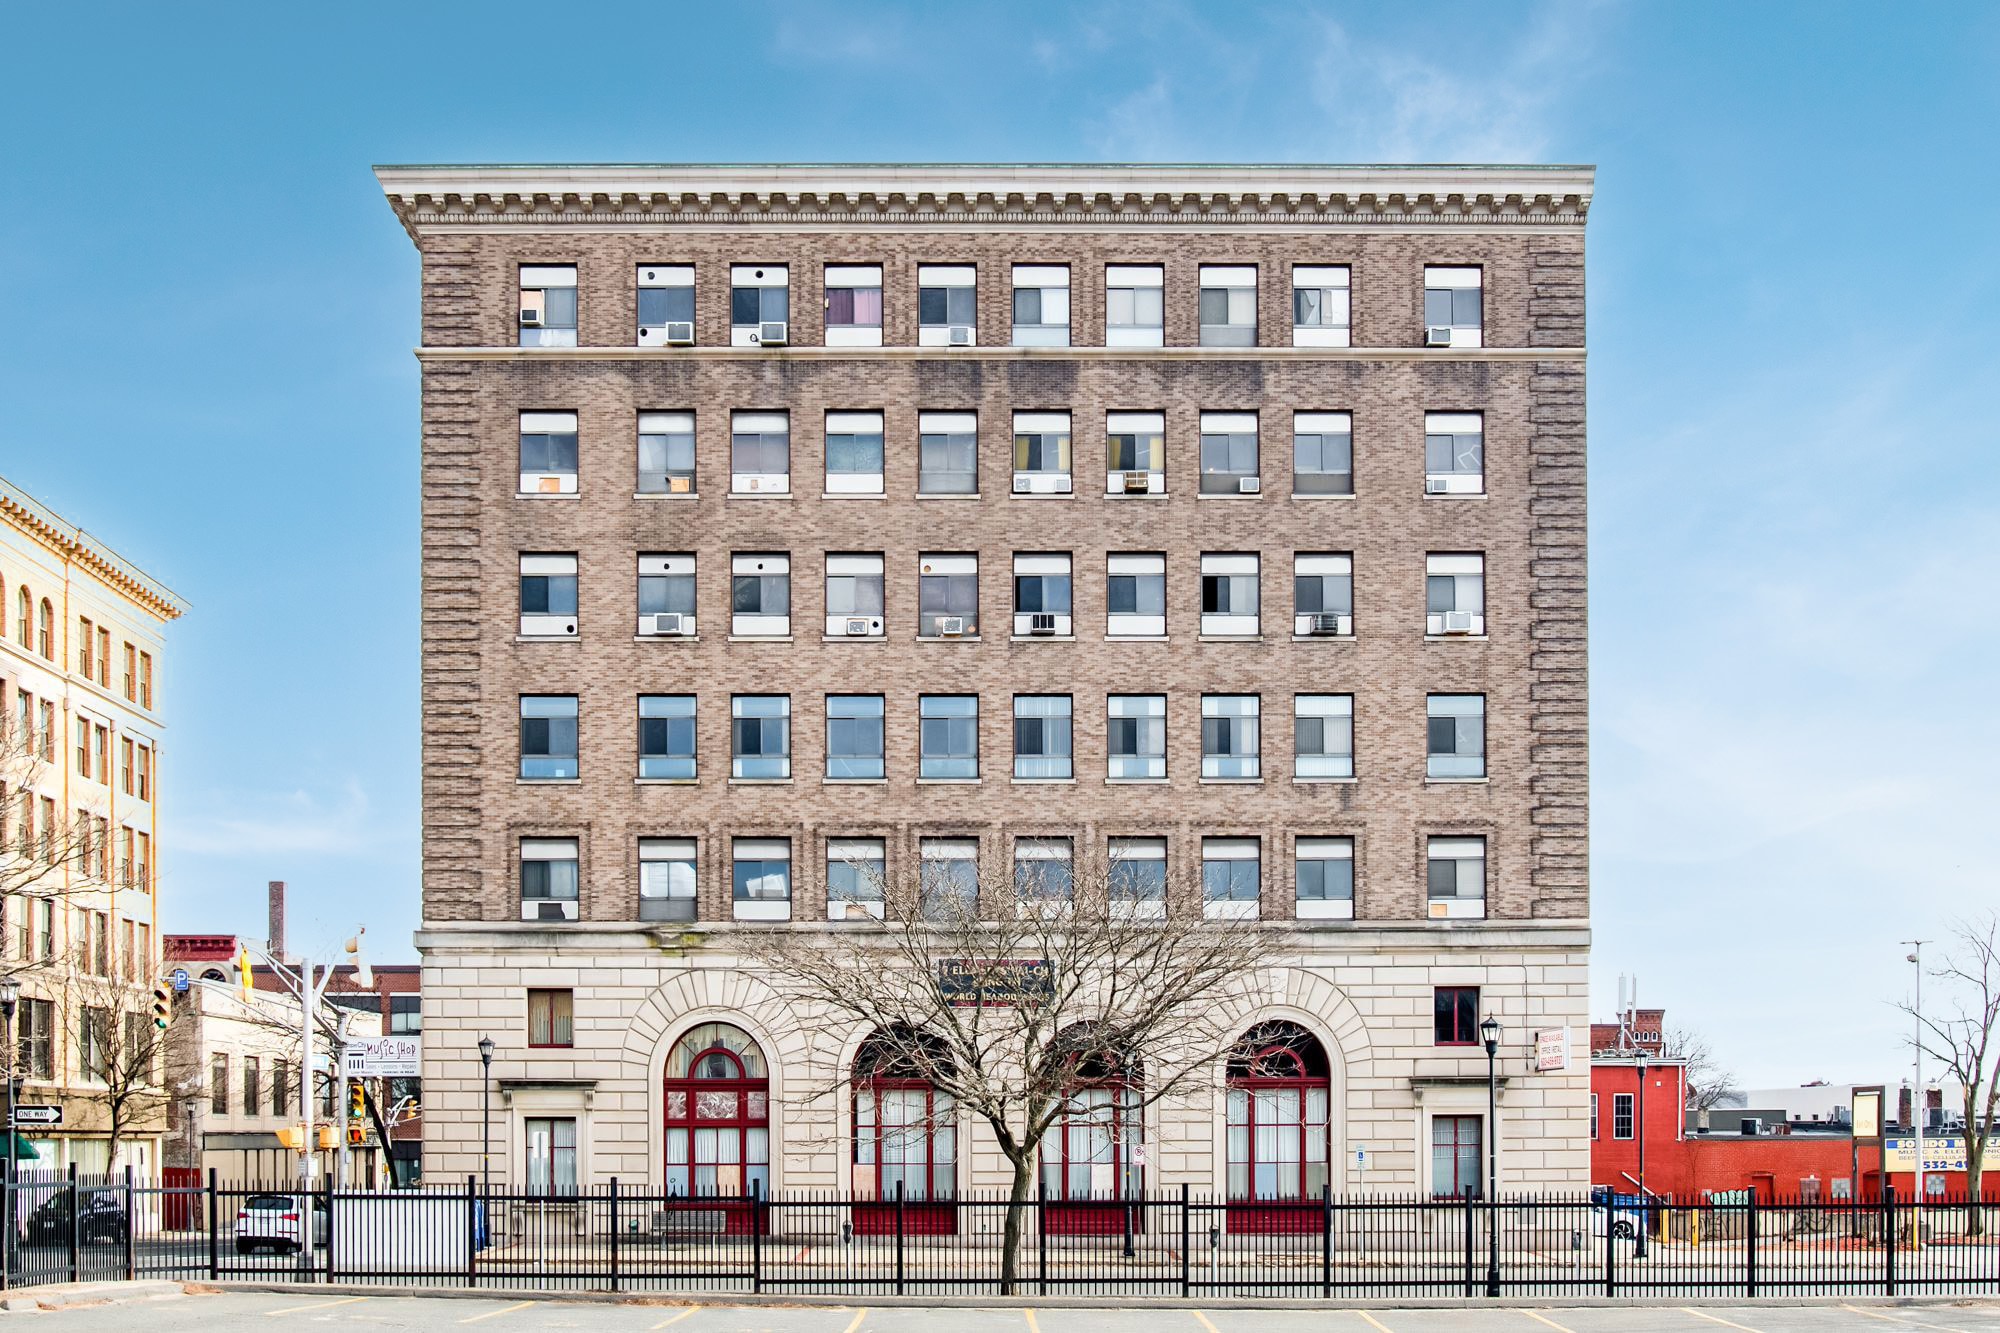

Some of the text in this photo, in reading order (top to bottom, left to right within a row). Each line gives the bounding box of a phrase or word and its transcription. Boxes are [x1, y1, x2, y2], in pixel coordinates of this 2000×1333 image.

[944, 992, 977, 1001] WORLD
[396, 1041, 416, 1059] SHOP
[18, 1110, 32, 1118] ONE
[1896, 1139, 1948, 1148] SOIDO
